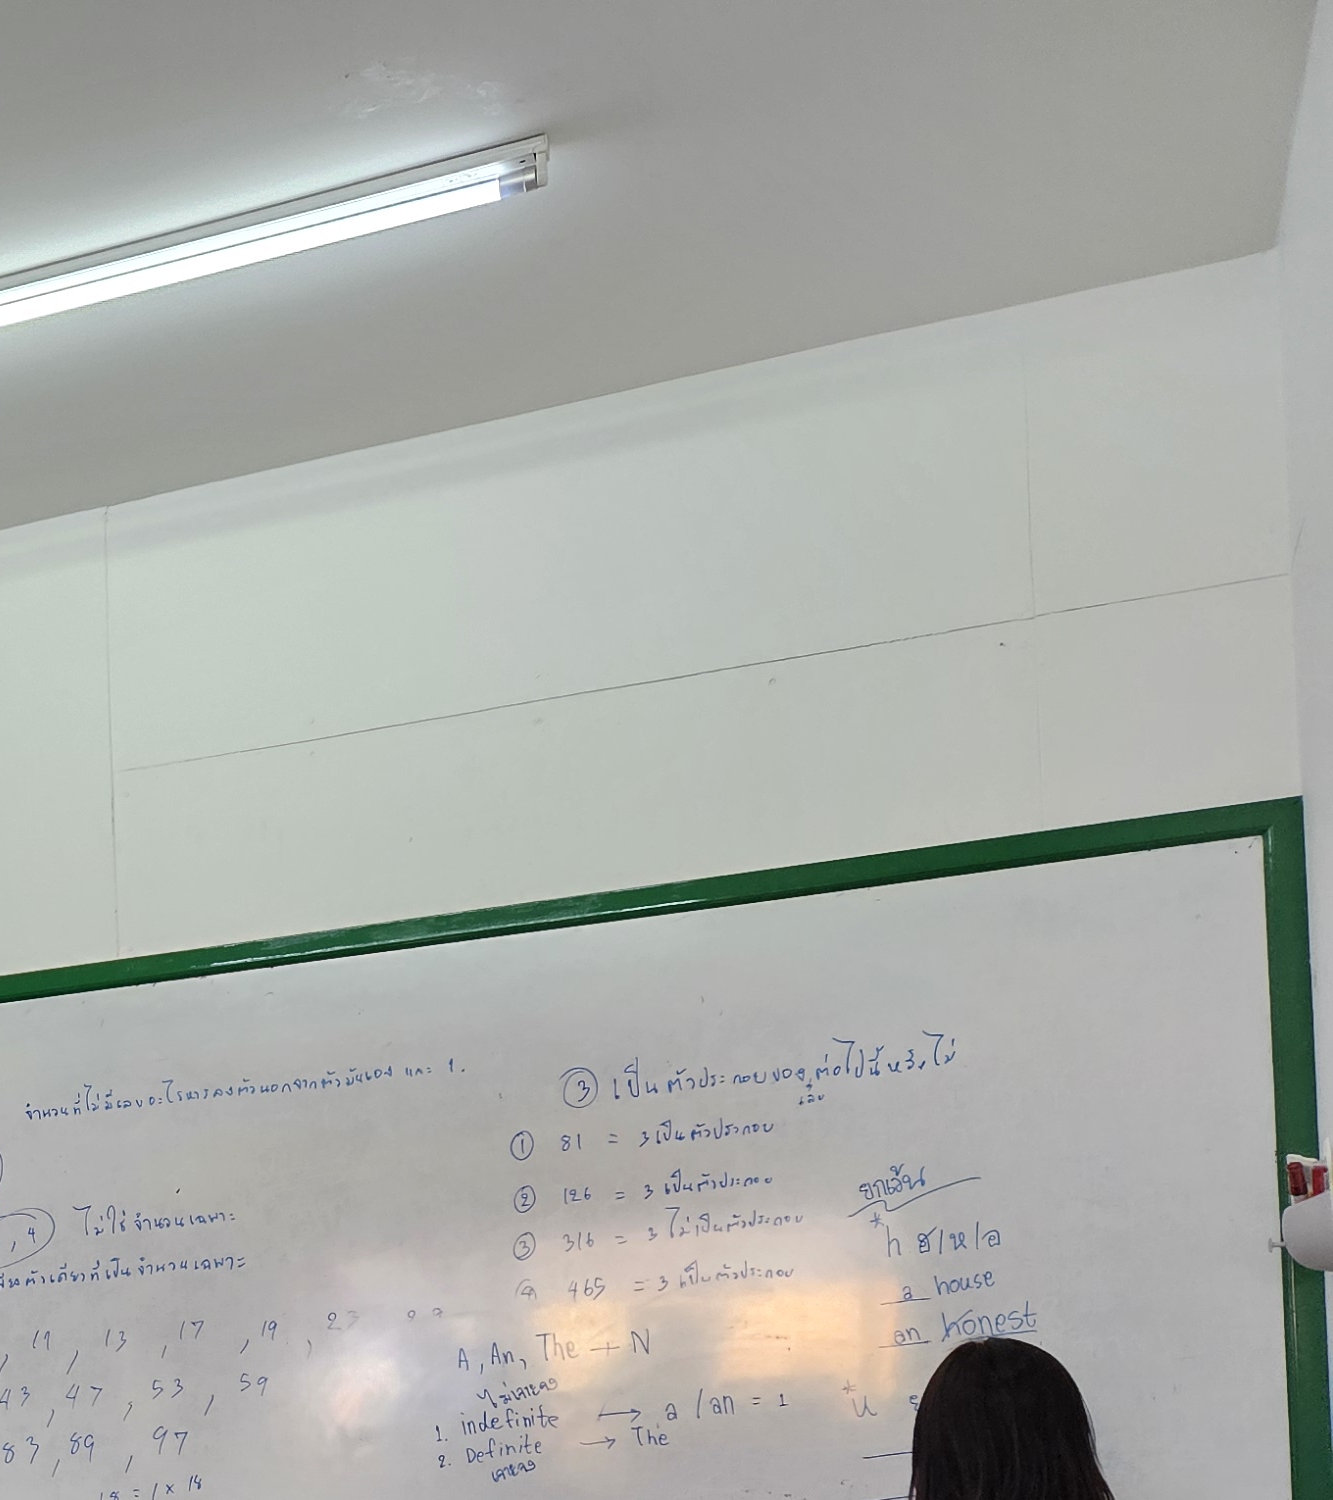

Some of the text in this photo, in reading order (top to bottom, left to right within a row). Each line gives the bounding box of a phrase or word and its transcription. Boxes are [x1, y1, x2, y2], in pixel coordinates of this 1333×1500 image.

[560, 1133, 582, 1152] 81
[858, 1163, 927, 1200] ยกเว้น
[563, 1186, 592, 1205] 126
[562, 1231, 595, 1253] 316
[886, 1226, 901, 1257] h
[568, 1276, 606, 1301] 465
[933, 1270, 996, 1296] house
[535, 1332, 577, 1362] The
[630, 1328, 650, 1355] N
[892, 1324, 922, 1344] an
[465, 1433, 542, 1464] Definite
